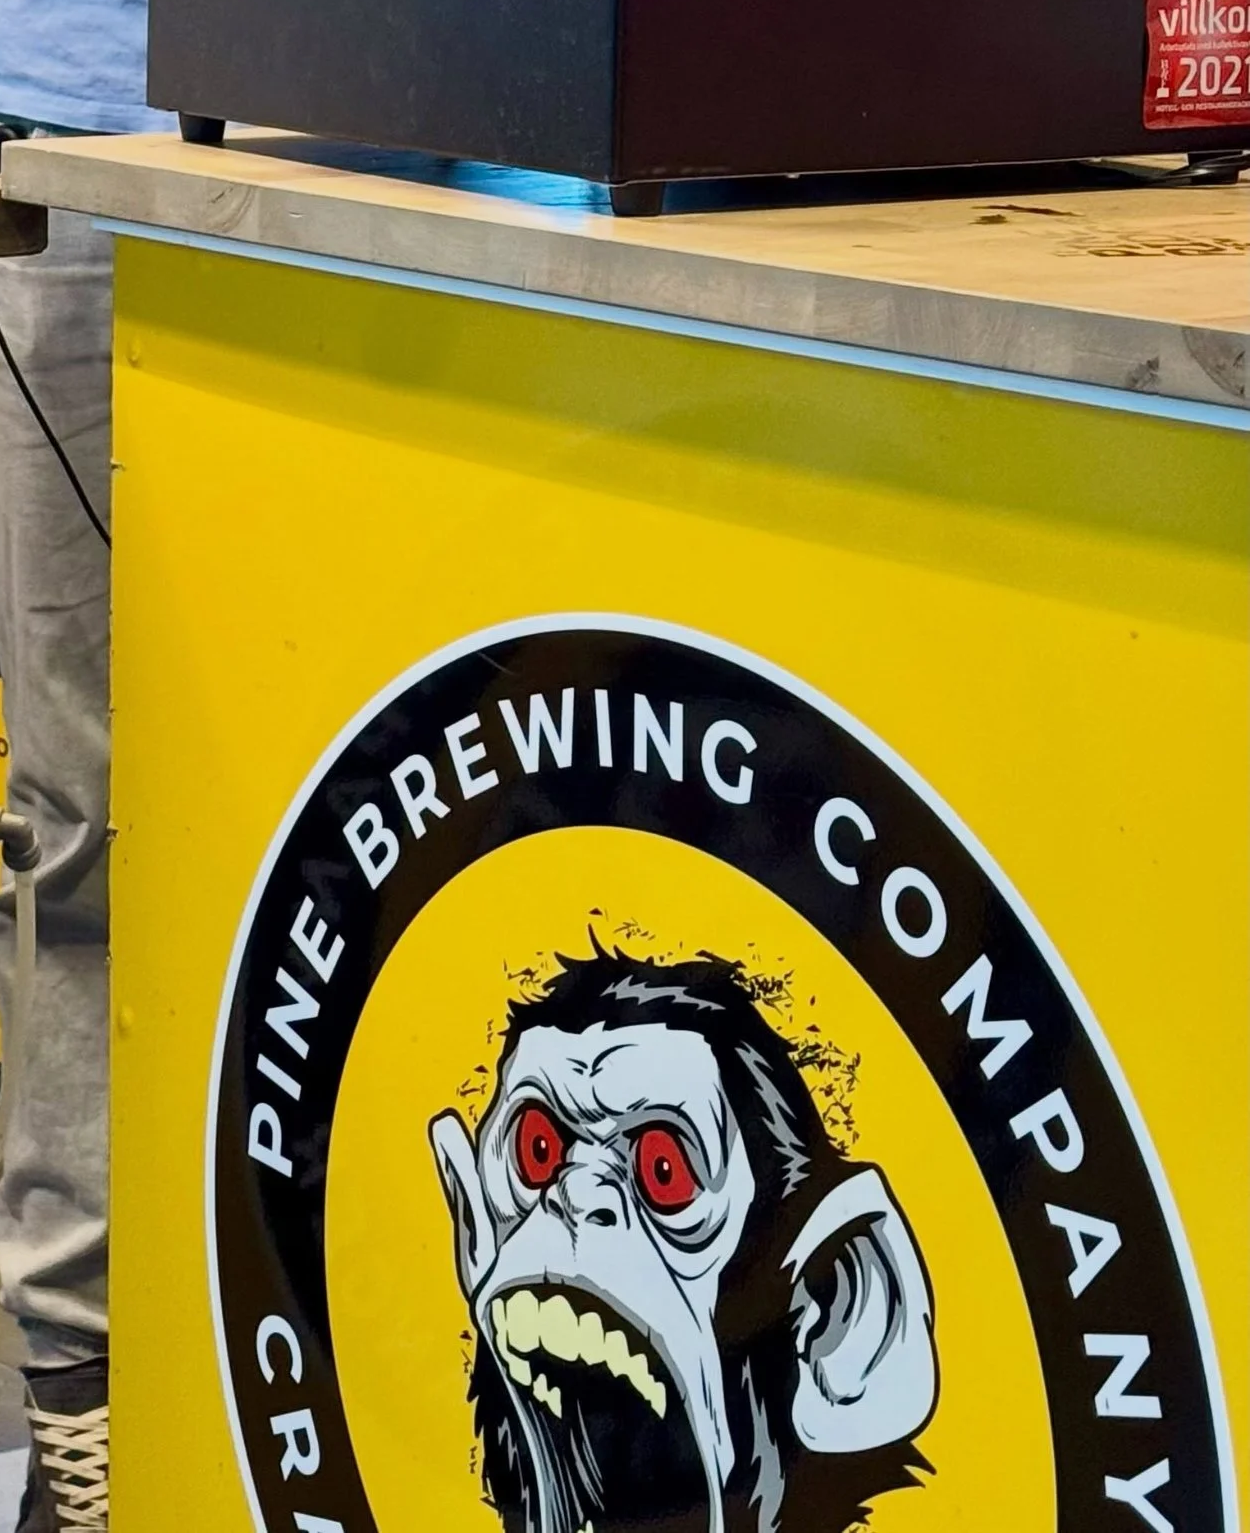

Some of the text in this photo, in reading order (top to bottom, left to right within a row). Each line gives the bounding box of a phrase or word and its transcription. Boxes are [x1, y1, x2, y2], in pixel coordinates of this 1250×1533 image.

[248, 686, 1176, 1533] PINE BREWING COMPANY
[256, 1313, 345, 1533] CR
